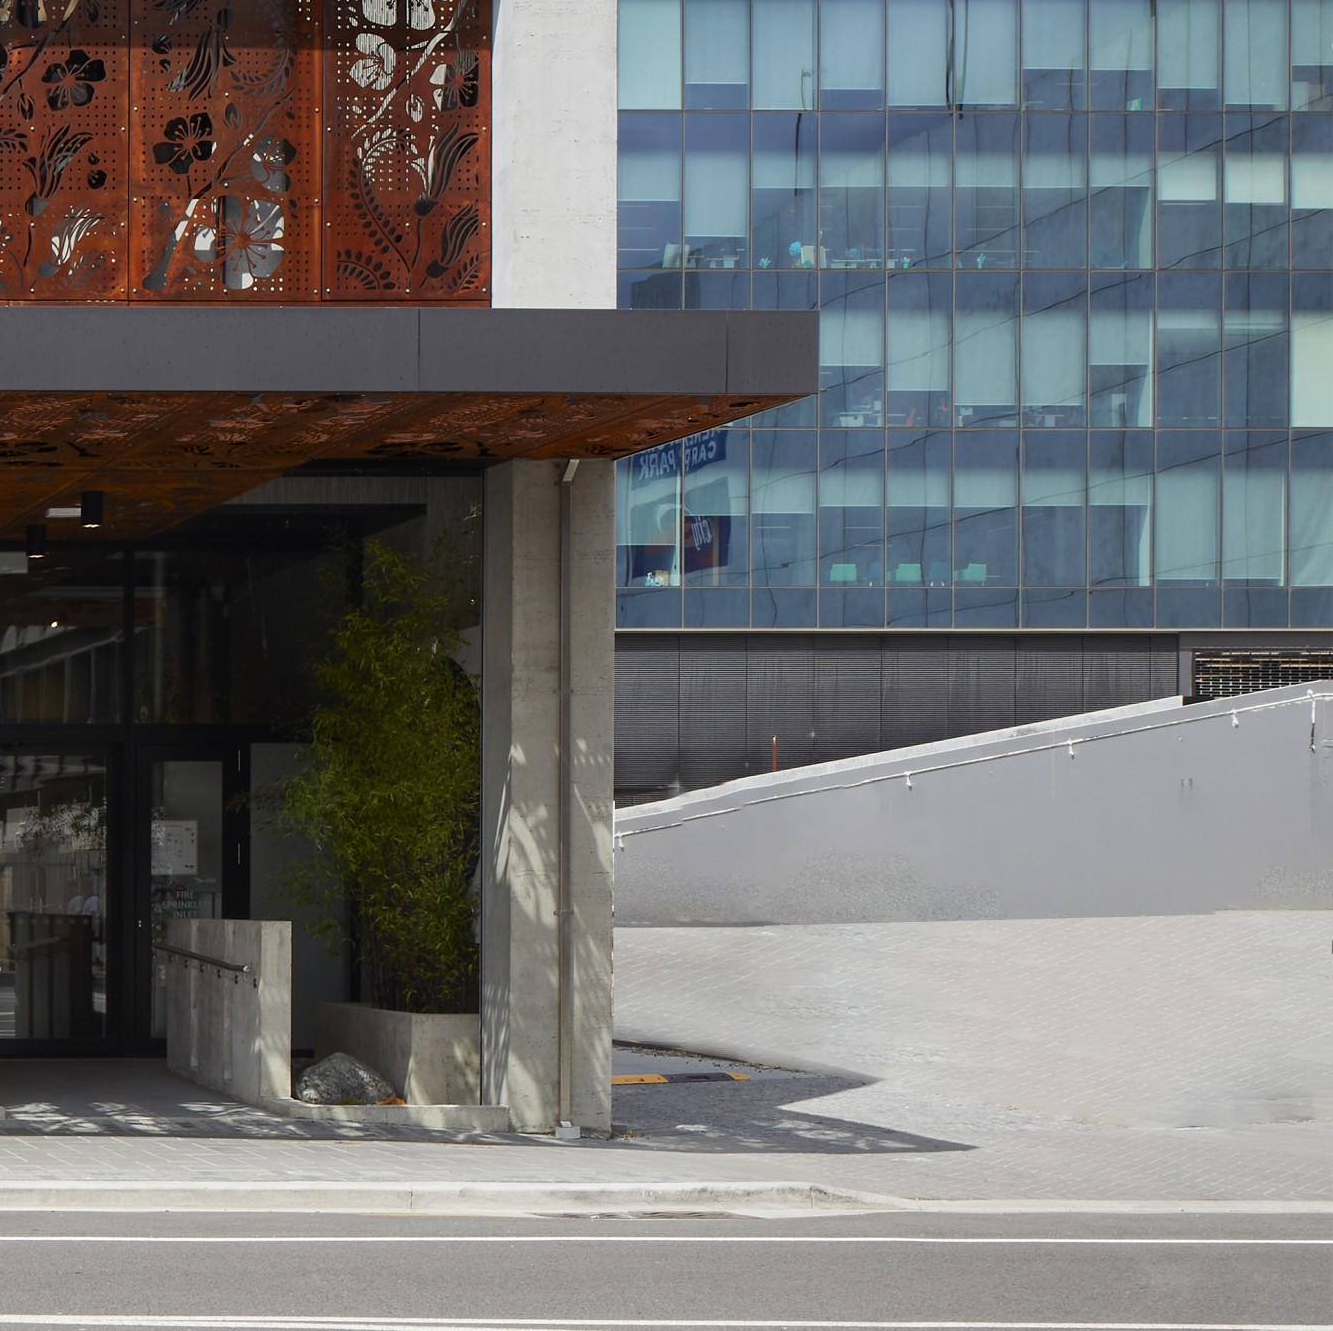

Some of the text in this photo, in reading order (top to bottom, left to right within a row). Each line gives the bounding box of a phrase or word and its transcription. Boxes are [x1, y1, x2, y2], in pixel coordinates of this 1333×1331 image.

[176, 891, 195, 899] FIRE
[162, 901, 207, 909] SPRINKLE
[173, 910, 197, 918] INLET
